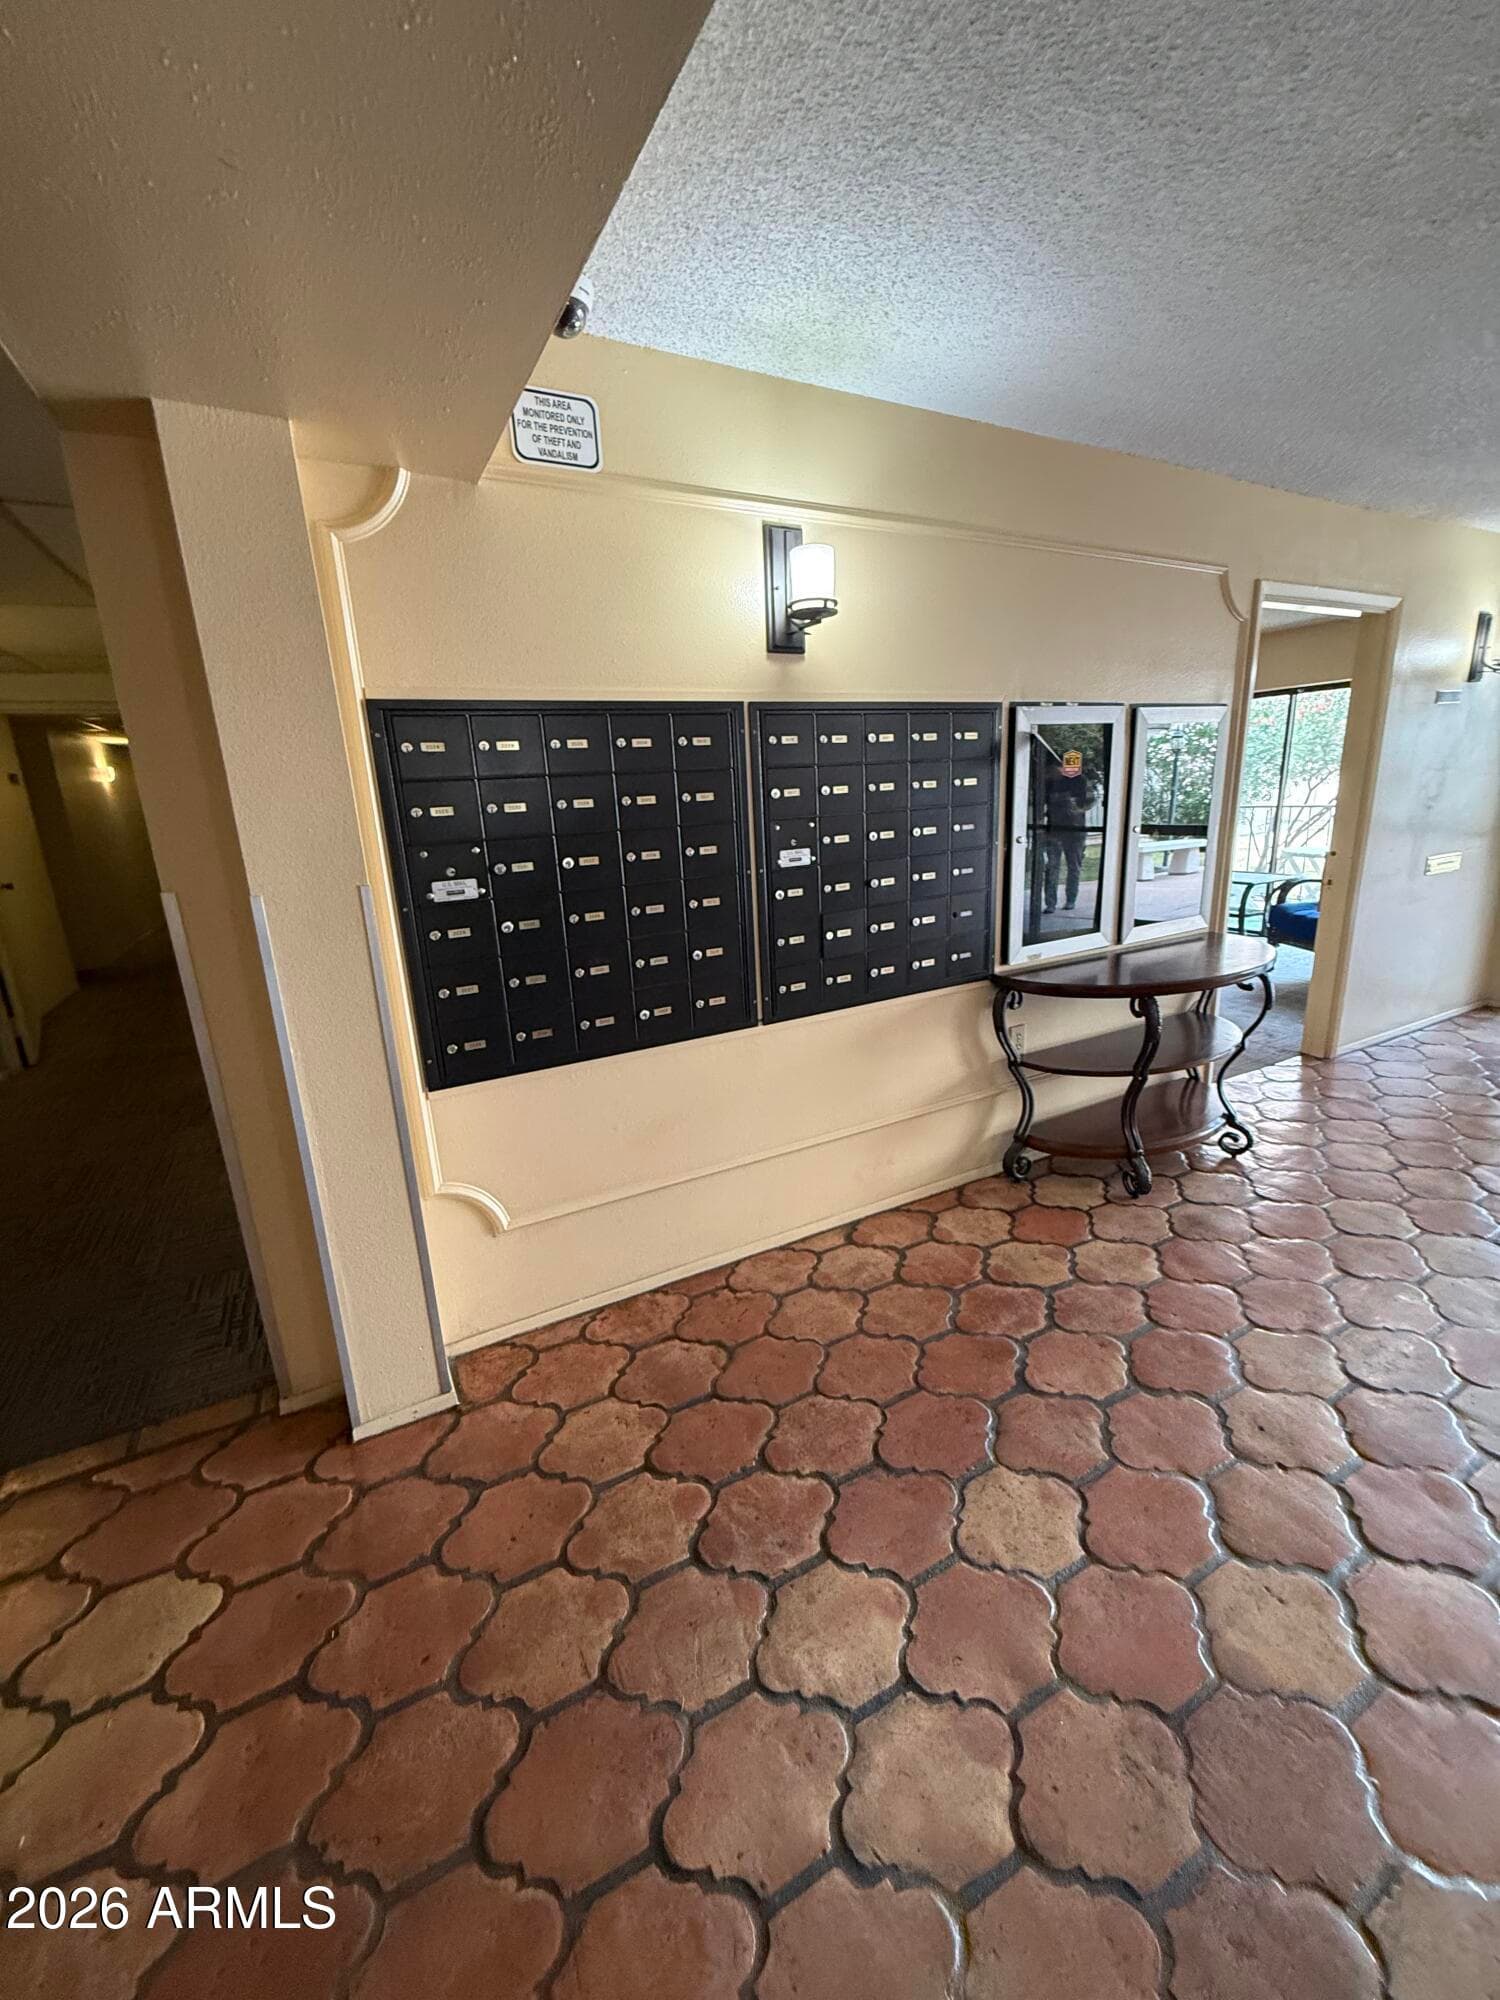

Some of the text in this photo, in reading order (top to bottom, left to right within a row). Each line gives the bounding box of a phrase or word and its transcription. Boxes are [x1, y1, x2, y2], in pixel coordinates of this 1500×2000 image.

[535, 396, 572, 411] THIS AREA
[522, 407, 585, 426] MONITORED ONLY
[516, 418, 593, 439] FOR THE PREVENTION
[531, 434, 582, 450] OF THEFT AND
[538, 448, 579, 461] VANDALISM
